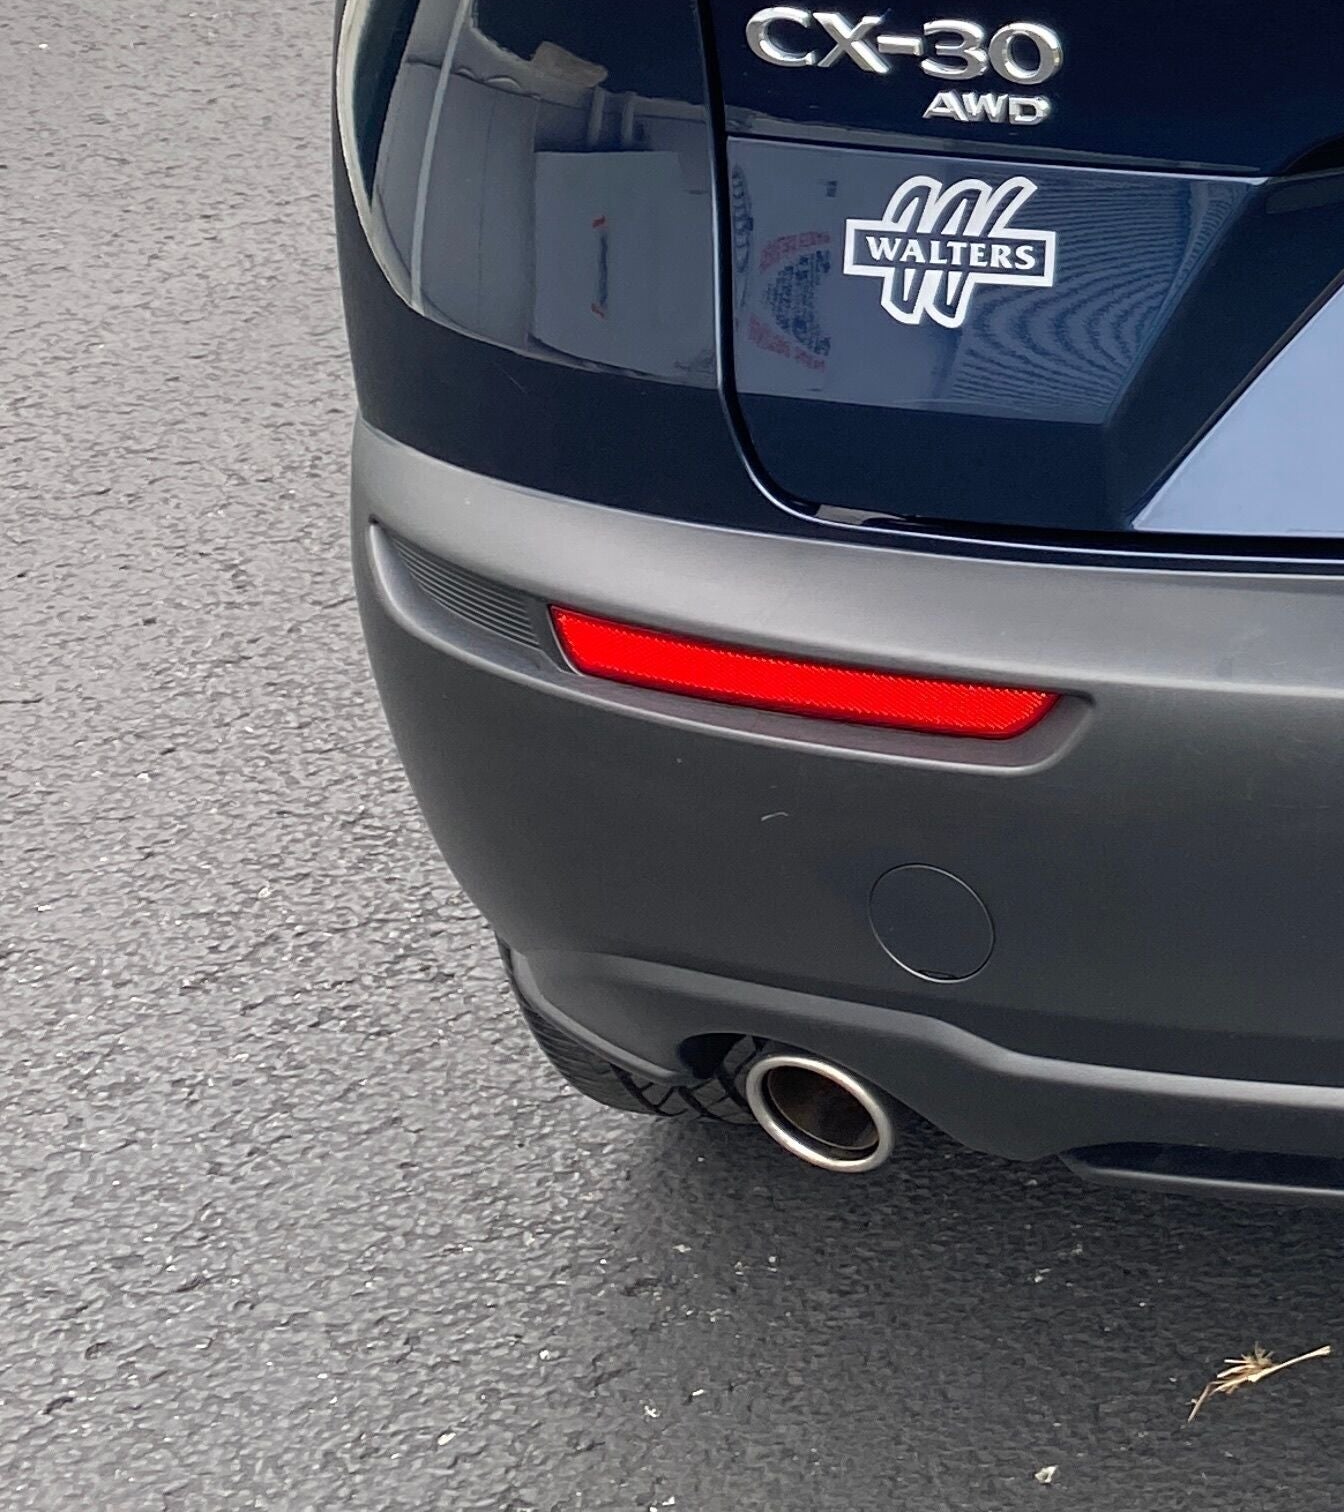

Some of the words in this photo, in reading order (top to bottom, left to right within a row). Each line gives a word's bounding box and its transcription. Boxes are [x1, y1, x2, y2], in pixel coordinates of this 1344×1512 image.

[745, 5, 1063, 85] CX-30
[922, 90, 1051, 126] AWD
[865, 235, 1037, 271] WALTERS
